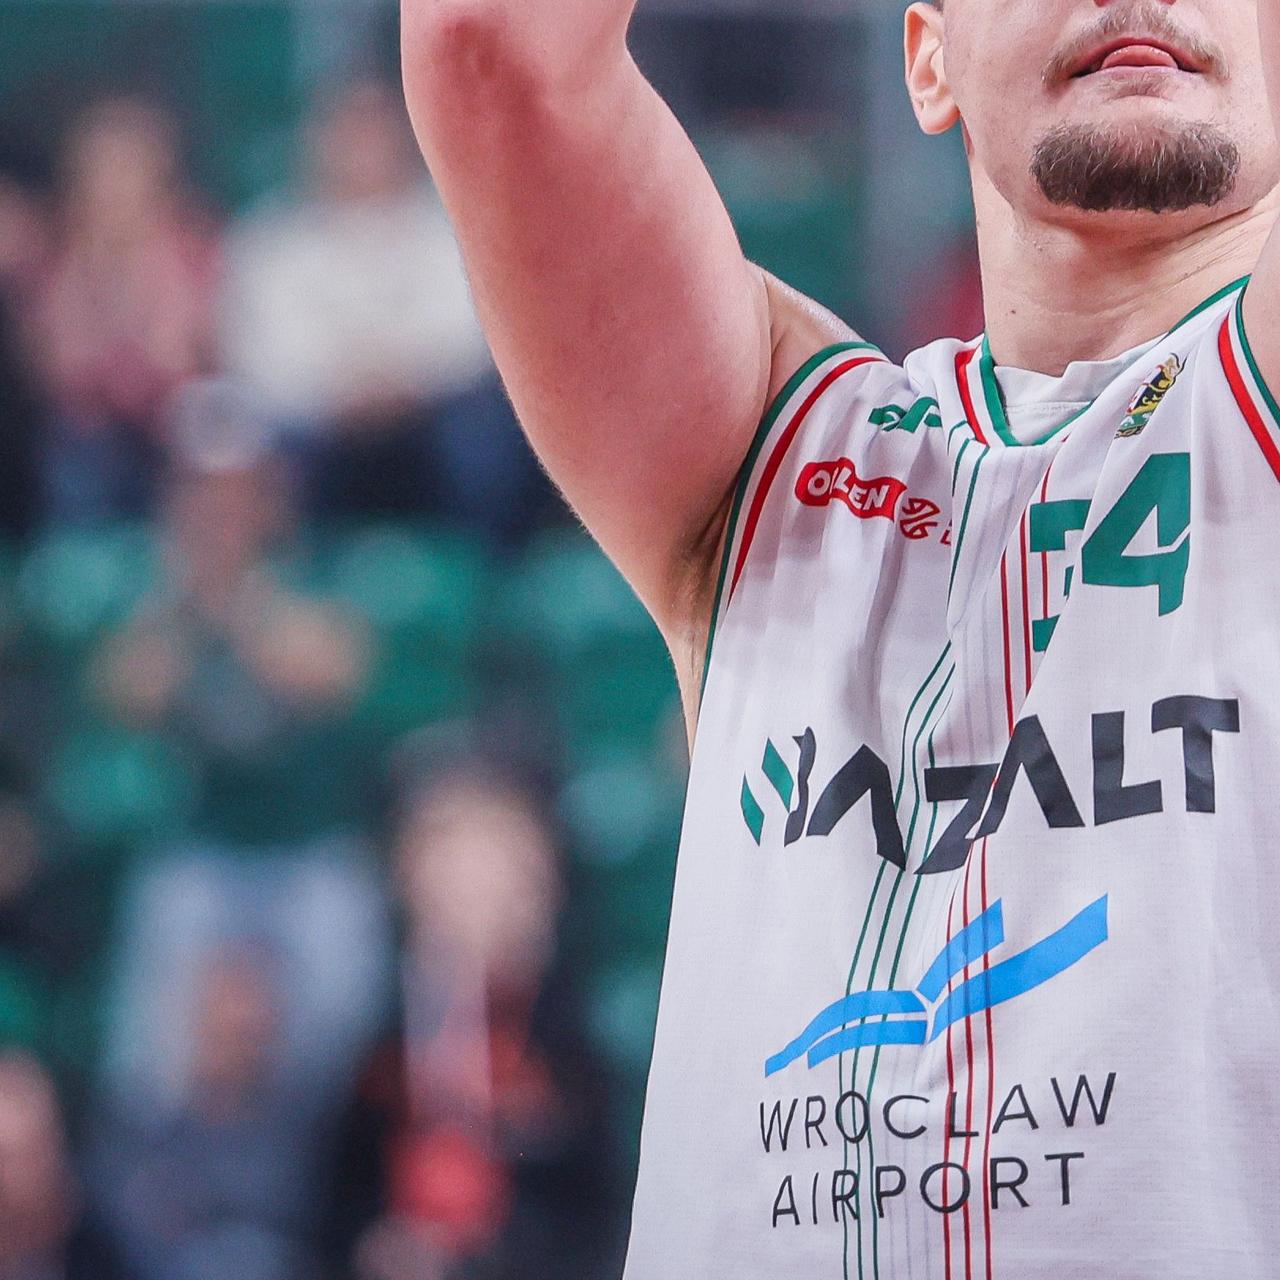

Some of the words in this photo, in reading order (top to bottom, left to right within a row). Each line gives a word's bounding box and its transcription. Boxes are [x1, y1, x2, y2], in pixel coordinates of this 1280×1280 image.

[806, 463, 891, 512] OLEN
[759, 1072, 1117, 1153] WROCLAW
[772, 1152, 1085, 1228] AIRPORT
